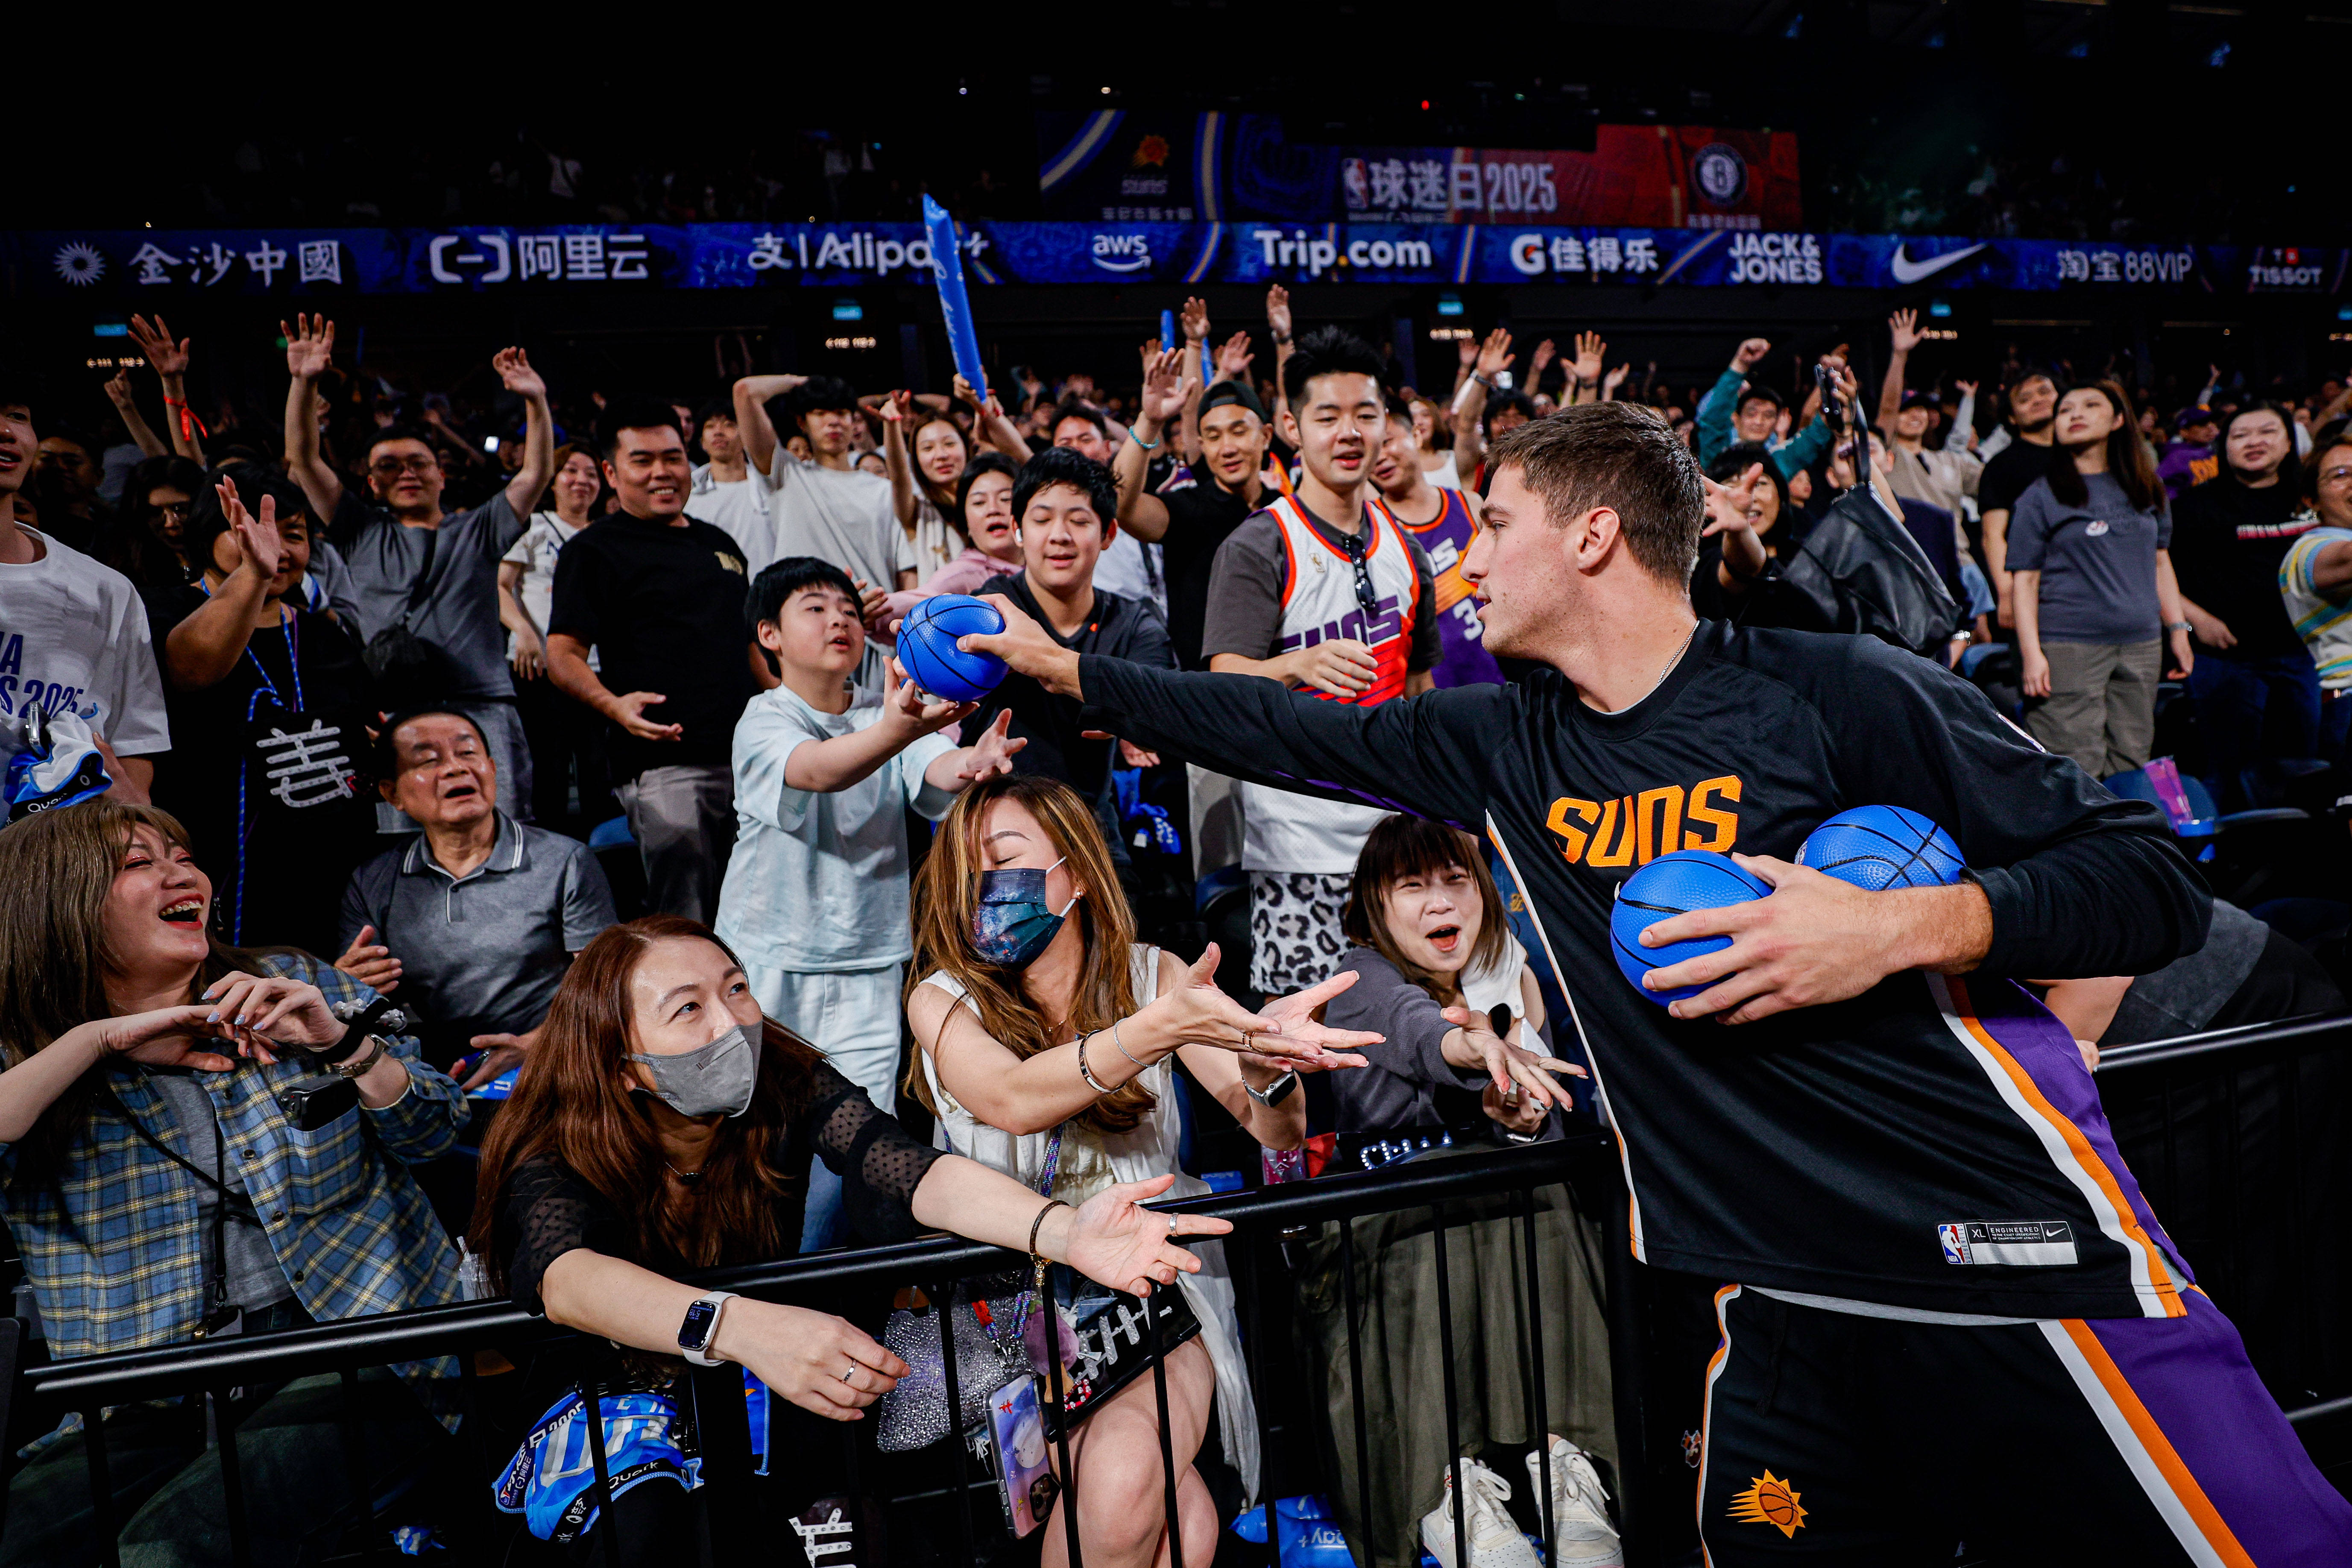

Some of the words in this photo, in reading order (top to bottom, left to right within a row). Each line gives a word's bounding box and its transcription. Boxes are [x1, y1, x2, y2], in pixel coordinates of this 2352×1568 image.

[1368, 158, 1558, 213] 球迷日2025
[129, 240, 342, 287] 金沙中國
[518, 234, 648, 280] 阿里云
[1092, 234, 1149, 256] aws
[1254, 229, 1432, 277] Trip.com
[1549, 236, 1659, 274] 佳得乐
[1728, 233, 1821, 257] JACK&
[1730, 257, 1823, 284] JONES
[2249, 265, 2323, 285] TISSOT
[1546, 775, 1743, 868] SUNS
[1971, 1229, 1986, 1238] XL
